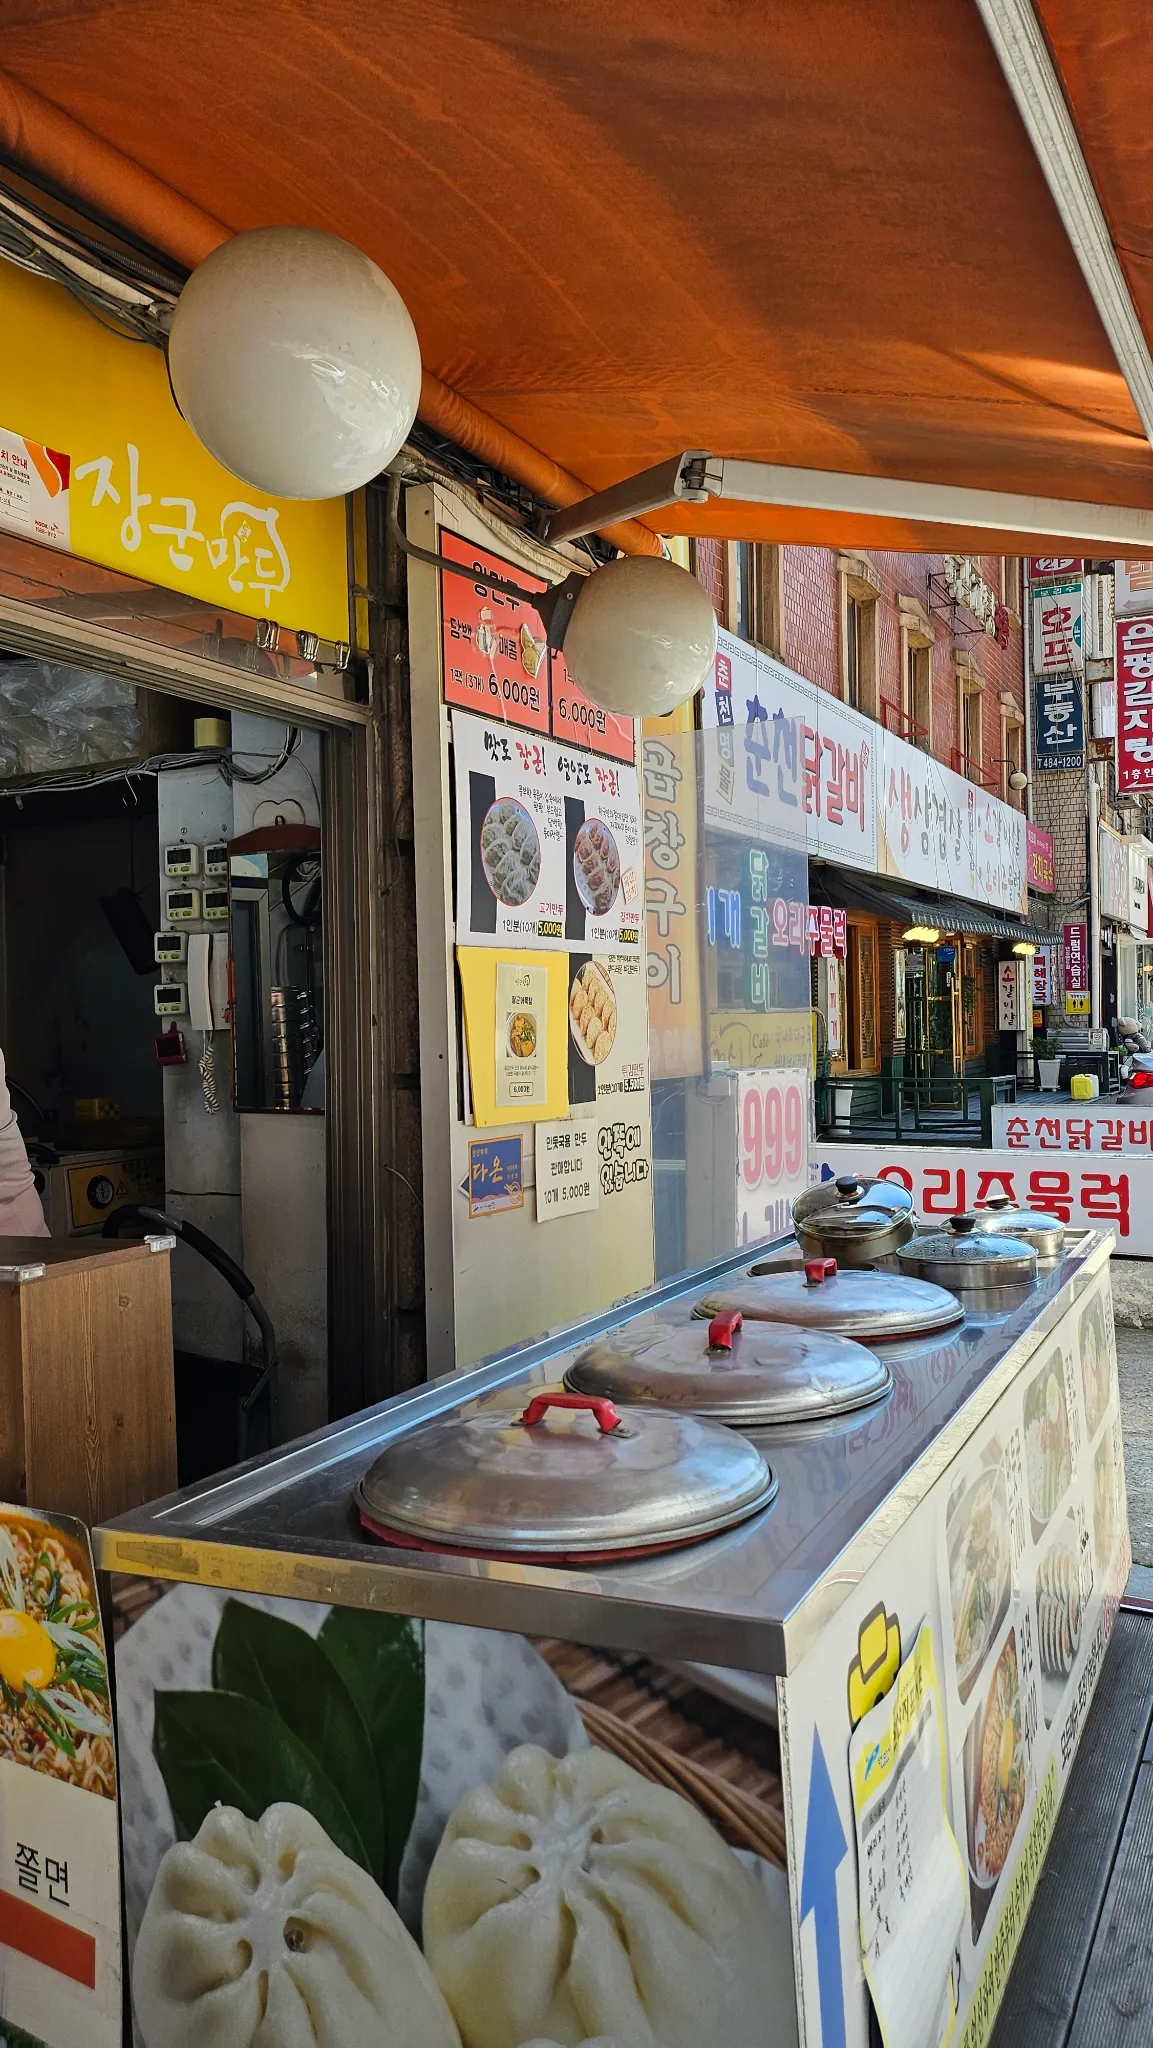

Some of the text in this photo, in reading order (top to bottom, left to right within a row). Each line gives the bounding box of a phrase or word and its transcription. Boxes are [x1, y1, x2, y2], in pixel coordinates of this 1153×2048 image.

[450, 617, 472, 644] 담백
[1042, 606, 1073, 667] 호프
[488, 674, 540, 712] 6,000원
[559, 697, 606, 735] 6,000원
[1043, 681, 1077, 745] 부동산
[484, 730, 511, 761] 맛도
[515, 742, 547, 776] 장군!
[594, 767, 620, 797] 장군!
[539, 902, 564, 916] 고기만두
[620, 911, 640, 924] 김치만두
[1070, 927, 1081, 989] 드럼연습실
[1002, 965, 1015, 1026] 소갈비살
[621, 1063, 645, 1077] 튀김만두
[574, 1132, 588, 1147] 만두
[597, 1122, 642, 1161] 안쪽에
[551, 1158, 583, 1176] 판매합니다
[600, 1159, 649, 1195] 있습니다
[543, 1182, 590, 1205] 10개 5,000원
[15, 1841, 70, 1908] 쫄면
